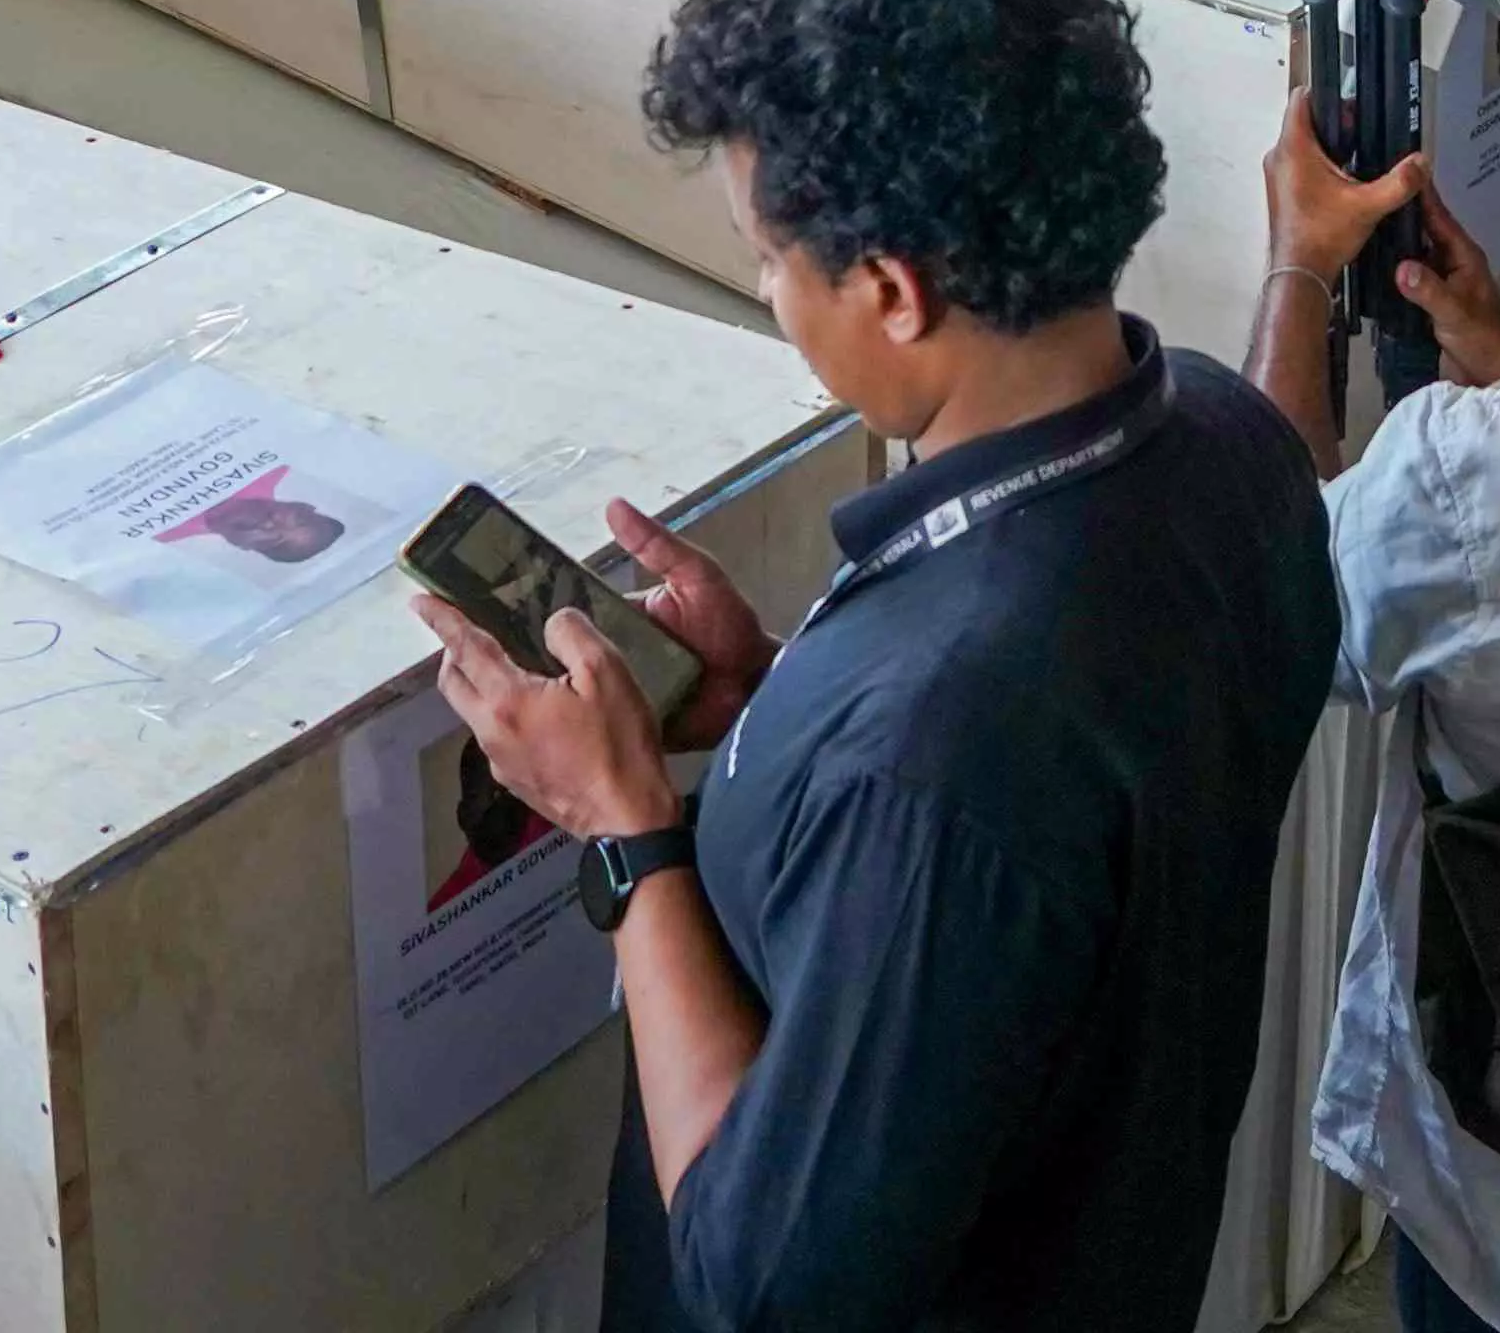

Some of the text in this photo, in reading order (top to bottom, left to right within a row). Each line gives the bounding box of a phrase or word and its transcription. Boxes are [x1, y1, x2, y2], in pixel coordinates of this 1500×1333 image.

[117, 451, 234, 517] GOVINDAN
[118, 450, 279, 539] SIVASHANKAR
[969, 469, 1037, 512] REVENUE
[1037, 427, 1125, 482] DEPARTMENT
[399, 868, 515, 957] SIVASHANKAR
